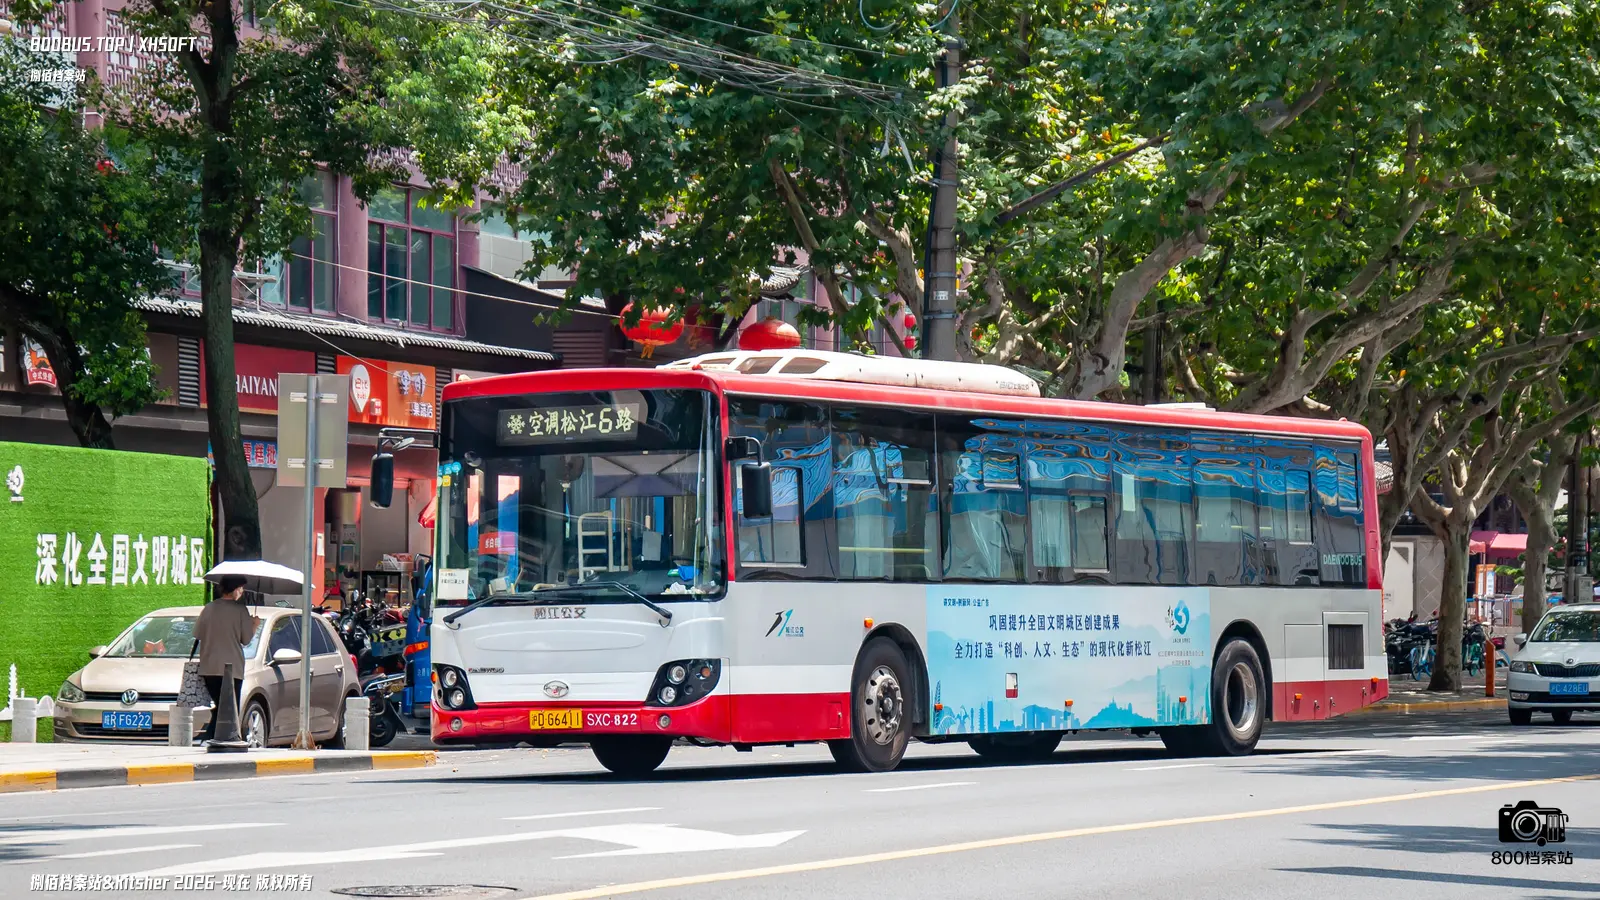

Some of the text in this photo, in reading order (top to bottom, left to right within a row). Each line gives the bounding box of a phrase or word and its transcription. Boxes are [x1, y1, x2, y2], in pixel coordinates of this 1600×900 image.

[529, 406, 634, 437] 空调松江6路
[35, 532, 205, 585] 深化全国文明城区
[1323, 554, 1350, 565] DAEWOO
[989, 614, 1120, 631] 巩固提升全国文明城区创建成果
